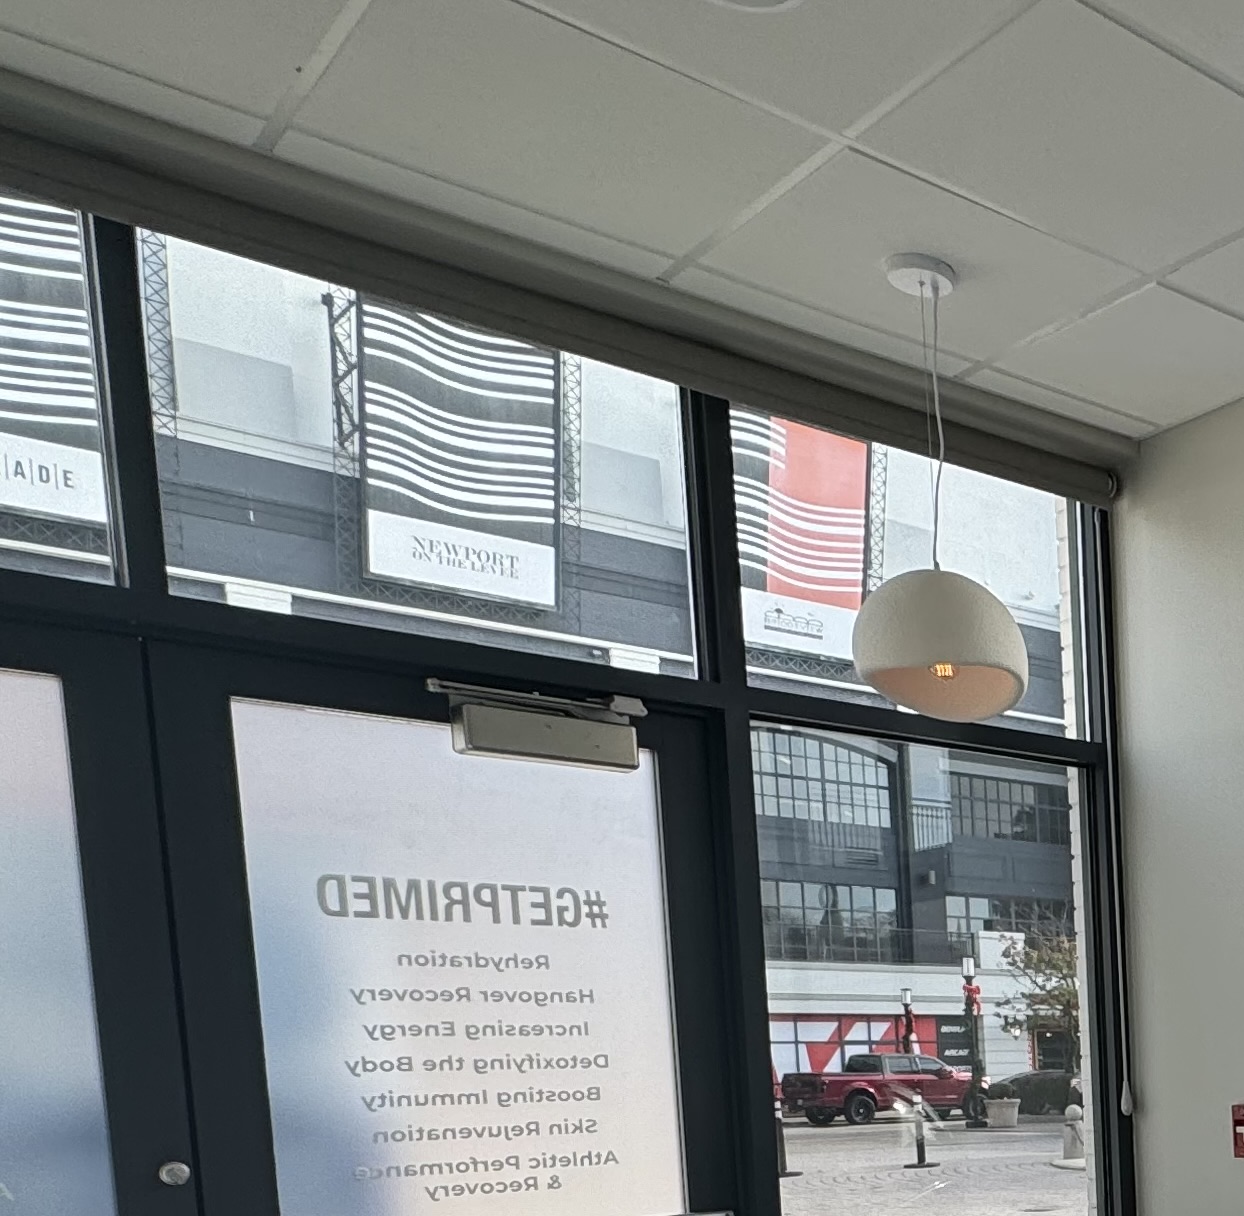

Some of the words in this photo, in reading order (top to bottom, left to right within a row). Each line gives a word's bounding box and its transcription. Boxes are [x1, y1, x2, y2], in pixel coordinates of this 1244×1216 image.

[412, 535, 520, 570] NEWPORT
[412, 547, 432, 562] ON
[436, 550, 467, 569] THE
